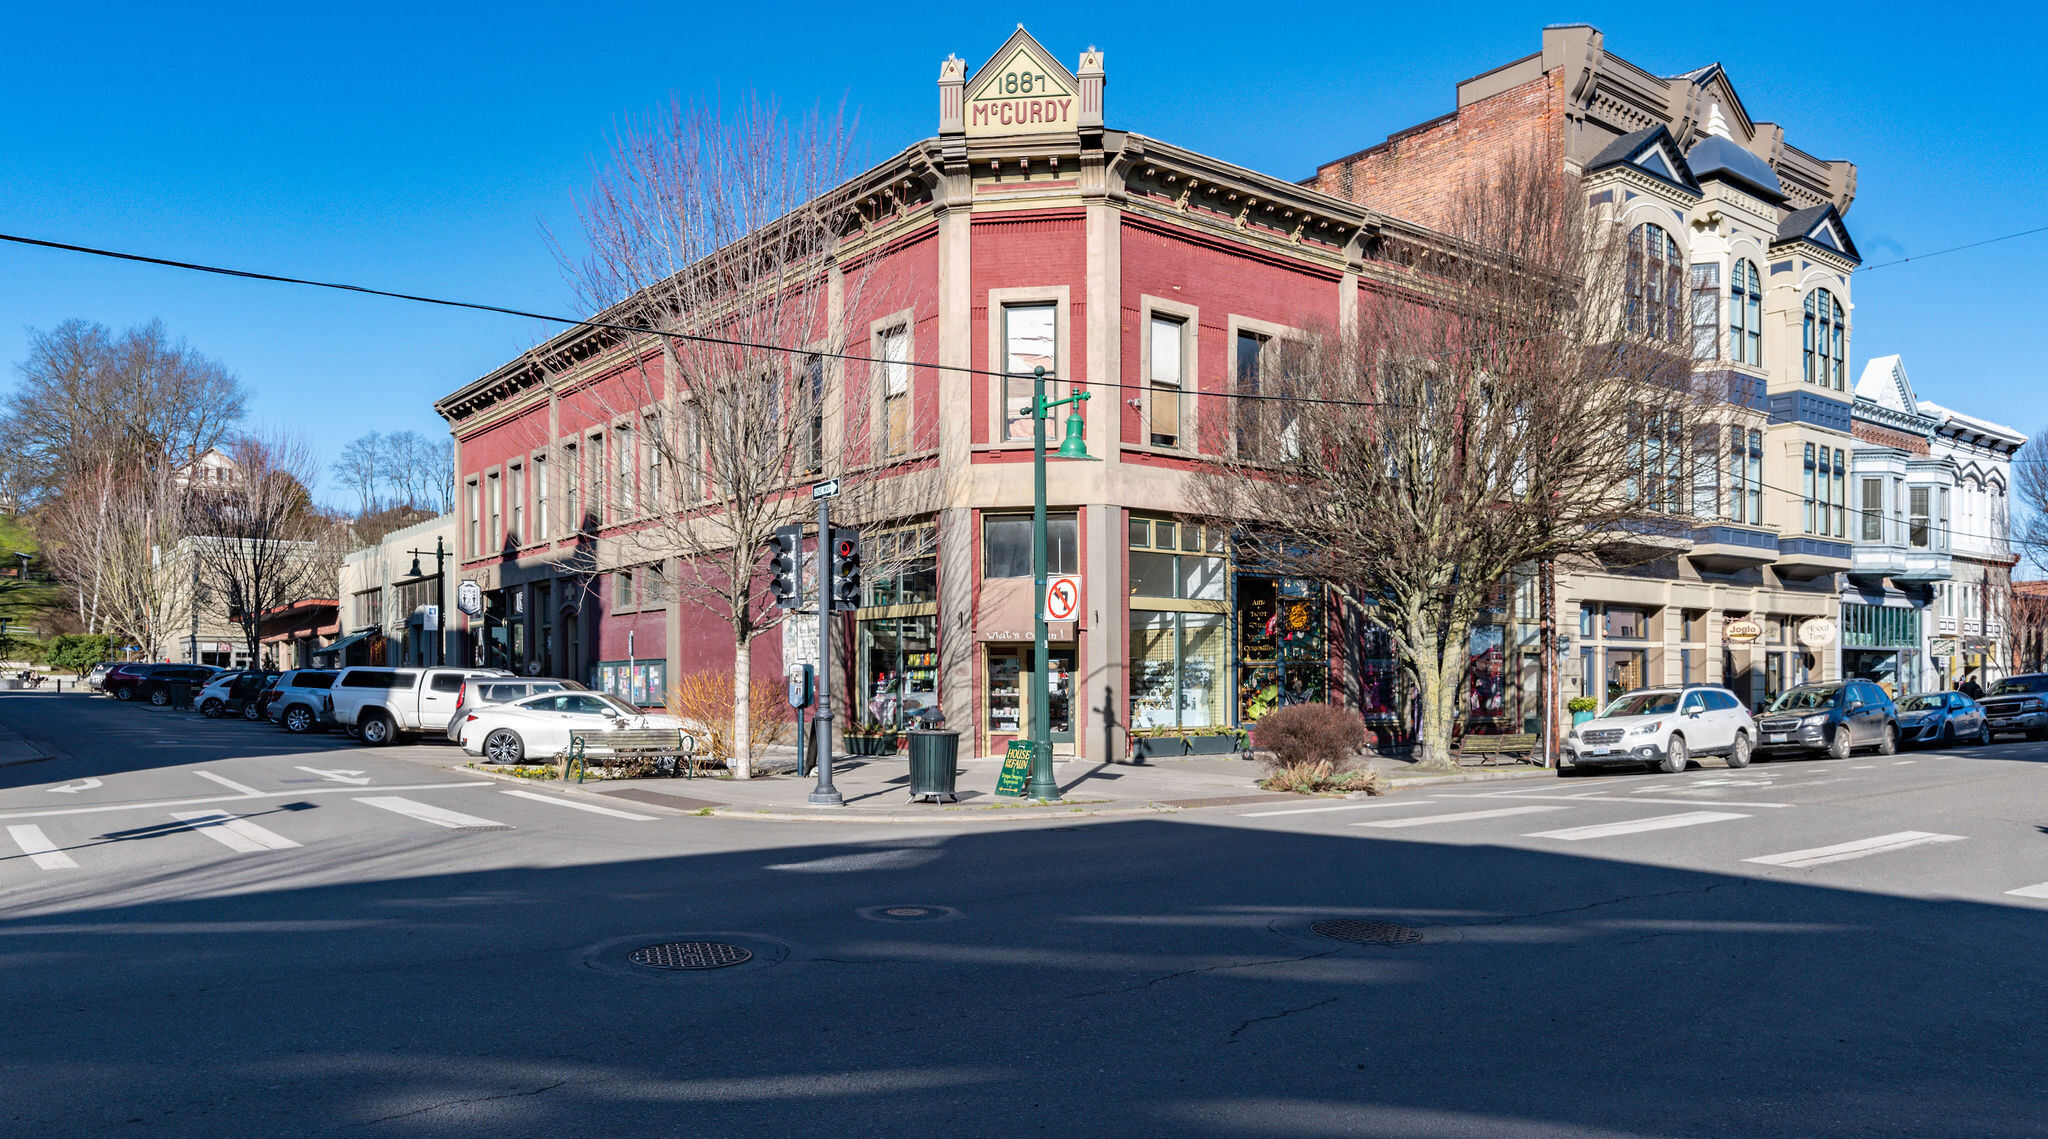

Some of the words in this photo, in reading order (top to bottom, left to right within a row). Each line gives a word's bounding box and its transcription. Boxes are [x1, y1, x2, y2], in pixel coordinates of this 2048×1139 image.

[999, 71, 1046, 95] 1887
[1007, 749, 1031, 759] HOUSE
[1011, 759, 1028, 769] FAUN
